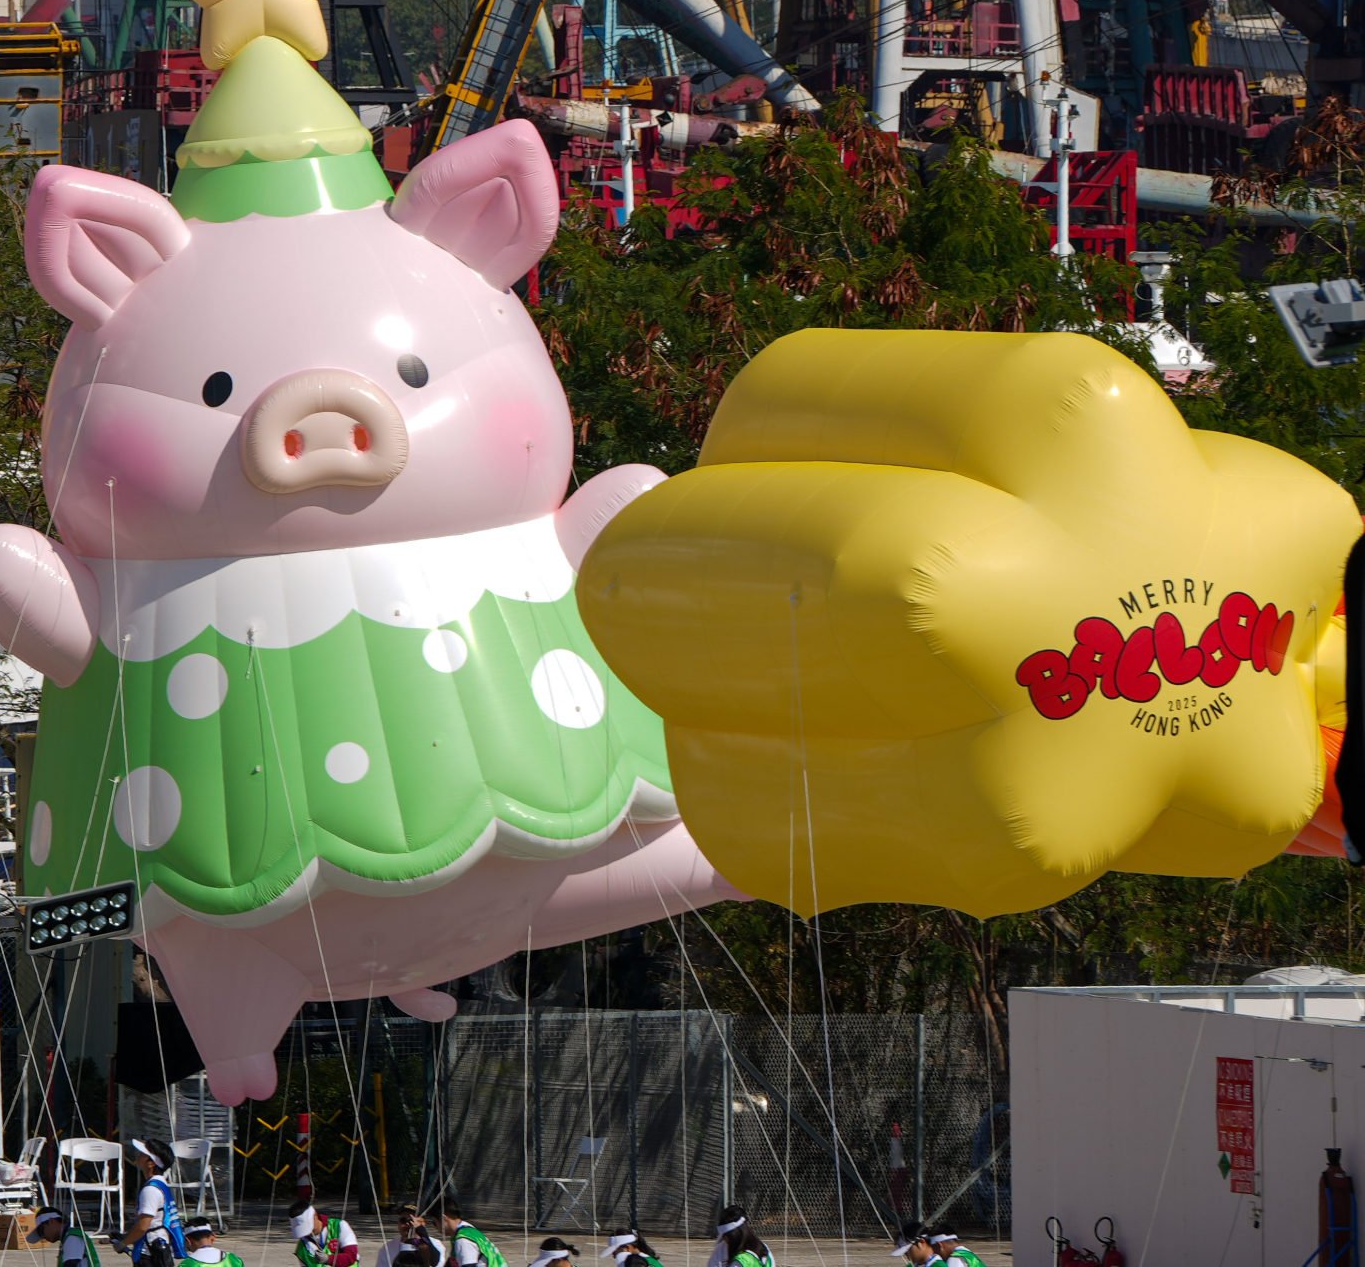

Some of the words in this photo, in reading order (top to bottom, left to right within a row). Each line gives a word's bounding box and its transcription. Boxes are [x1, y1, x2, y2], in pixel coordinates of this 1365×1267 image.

[1118, 578, 1214, 620] MERRY
[1016, 591, 1295, 720] BALLOON
[1130, 708, 1180, 736] HONG
[1188, 692, 1233, 732] KONG
[1168, 696, 1198, 713] 2025
